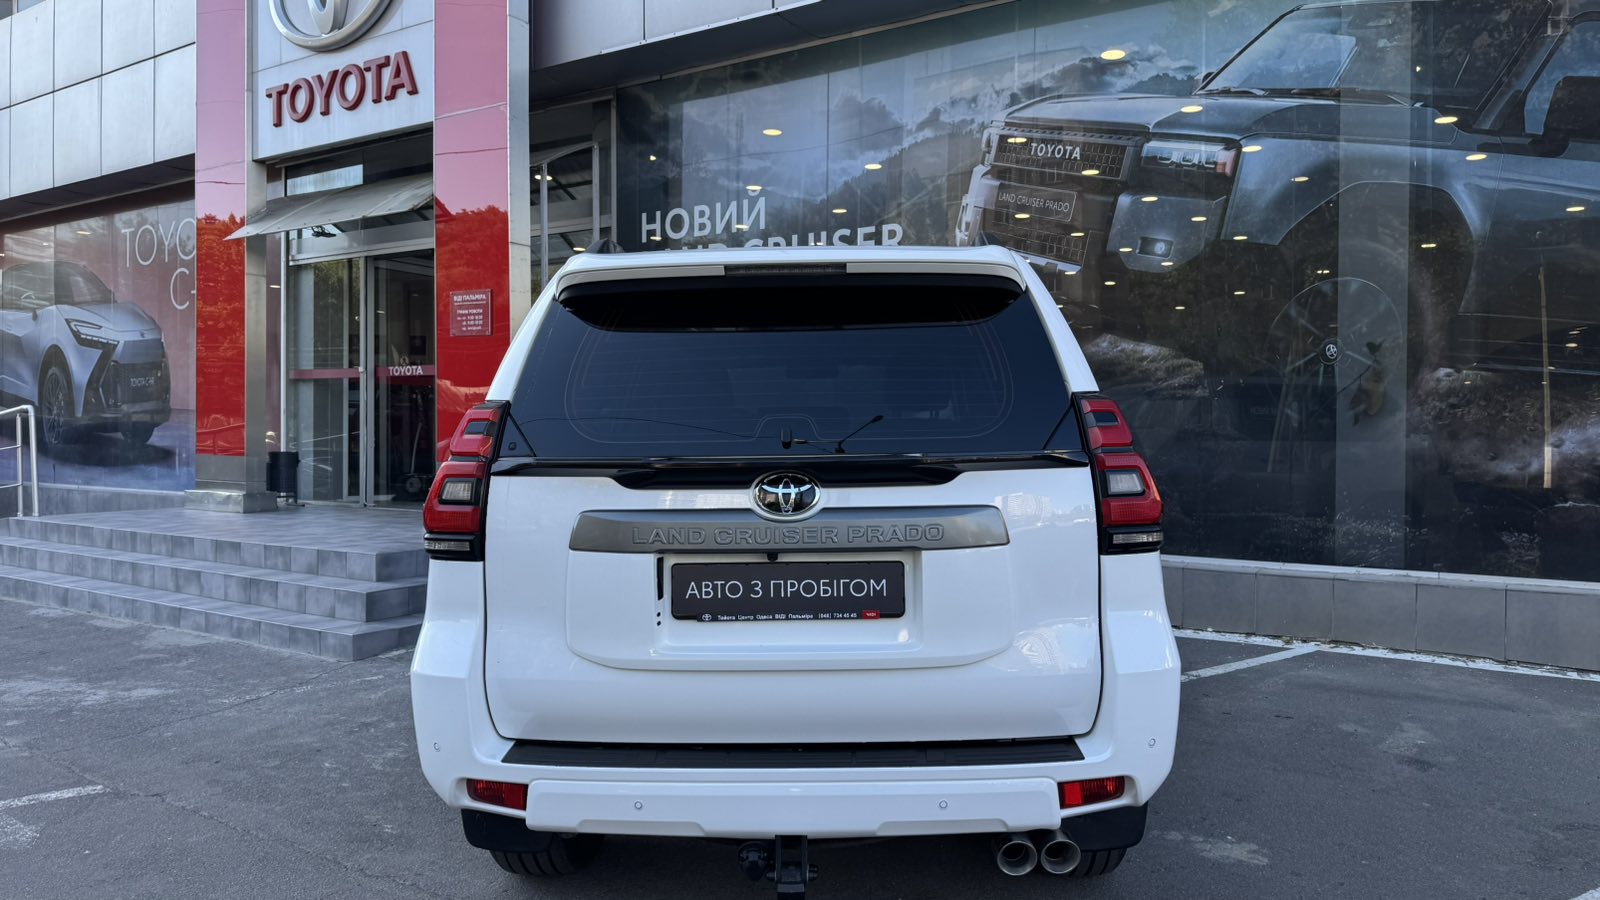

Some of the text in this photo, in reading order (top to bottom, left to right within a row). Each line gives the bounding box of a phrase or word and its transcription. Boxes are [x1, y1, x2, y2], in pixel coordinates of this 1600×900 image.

[265, 51, 419, 127] TOYOTA
[1030, 143, 1081, 160] TOYOTA
[999, 192, 1070, 213] LAND CRUISER PRADO
[641, 189, 766, 243] НОВИЙ
[743, 223, 903, 248] ISER
[388, 365, 423, 377] TOYOTA
[632, 523, 944, 546] LAND CRUISER PRADO
[686, 578, 888, 600] АВТО З ПРОБІГОМ
